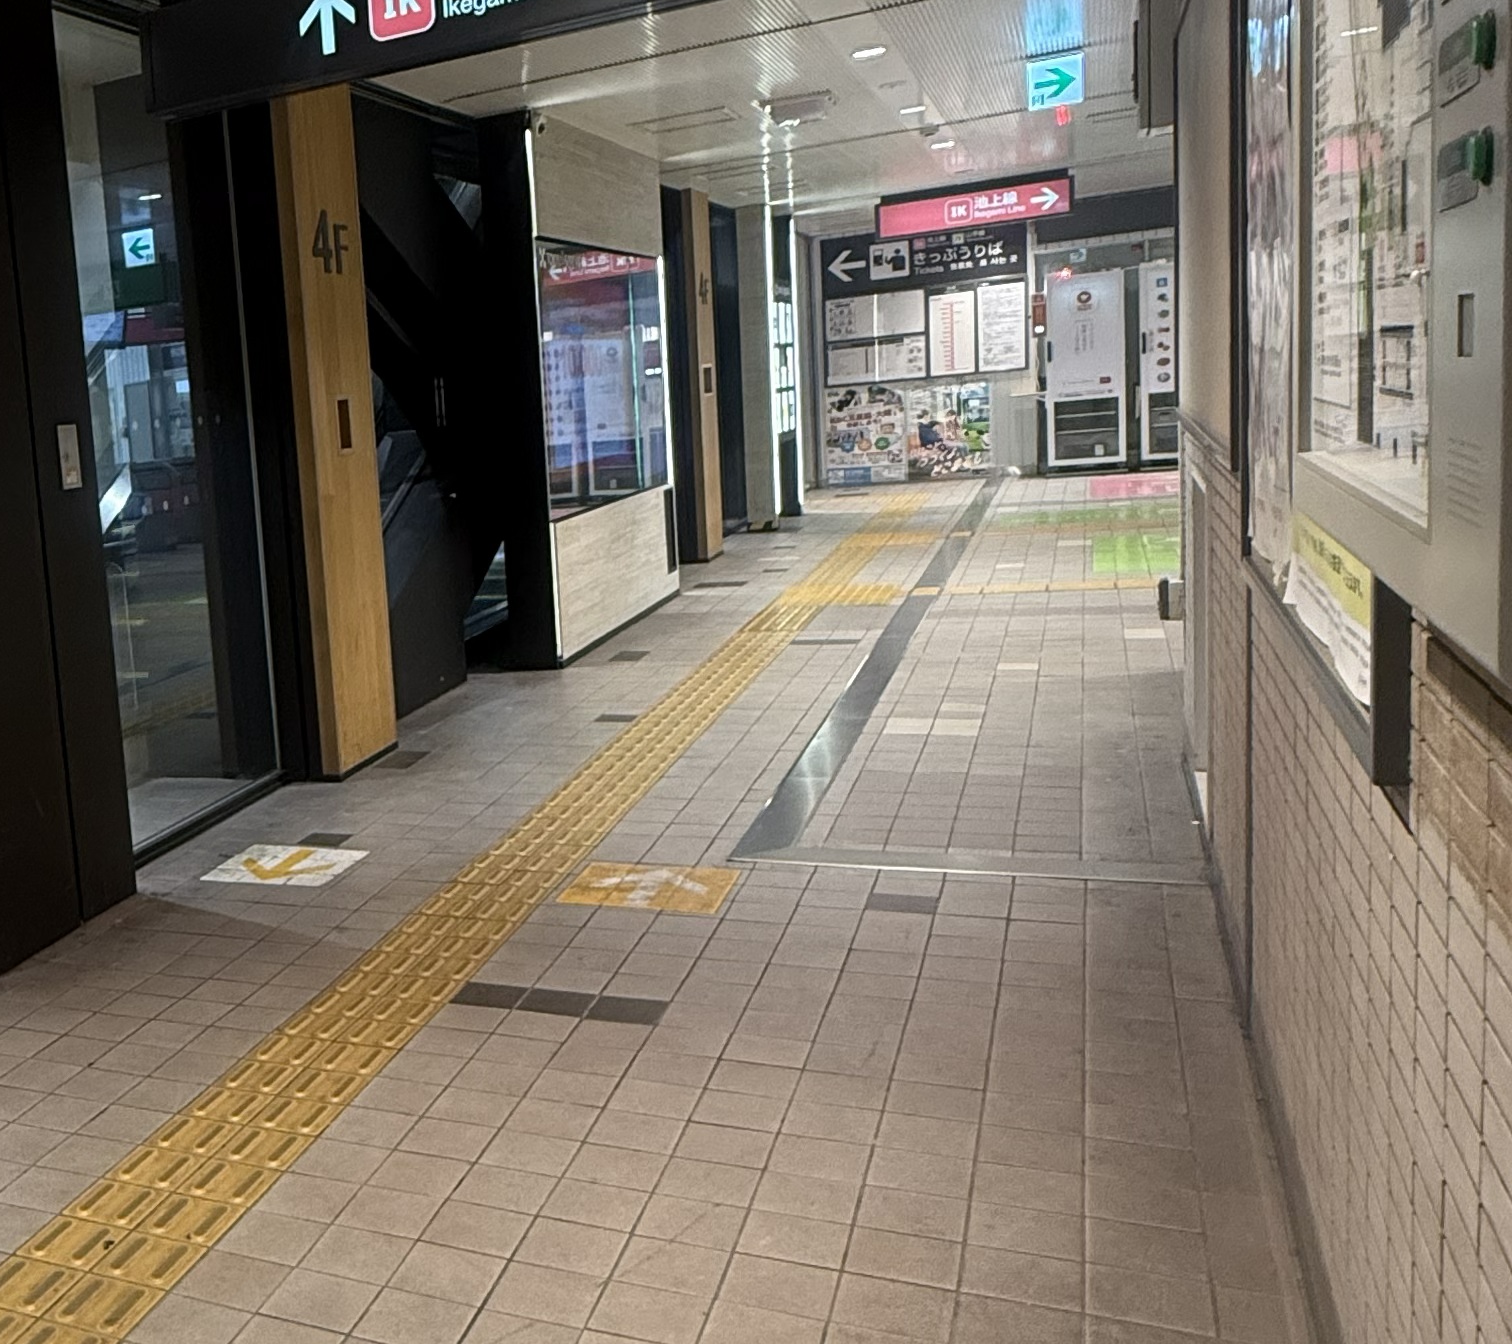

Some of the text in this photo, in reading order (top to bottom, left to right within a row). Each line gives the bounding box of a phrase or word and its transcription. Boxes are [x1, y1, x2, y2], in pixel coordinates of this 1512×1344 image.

[975, 192, 1017, 208] 池上線
[951, 206, 967, 217] IK
[312, 209, 349, 274] 4F
[913, 240, 1004, 266] きっぷうりば
